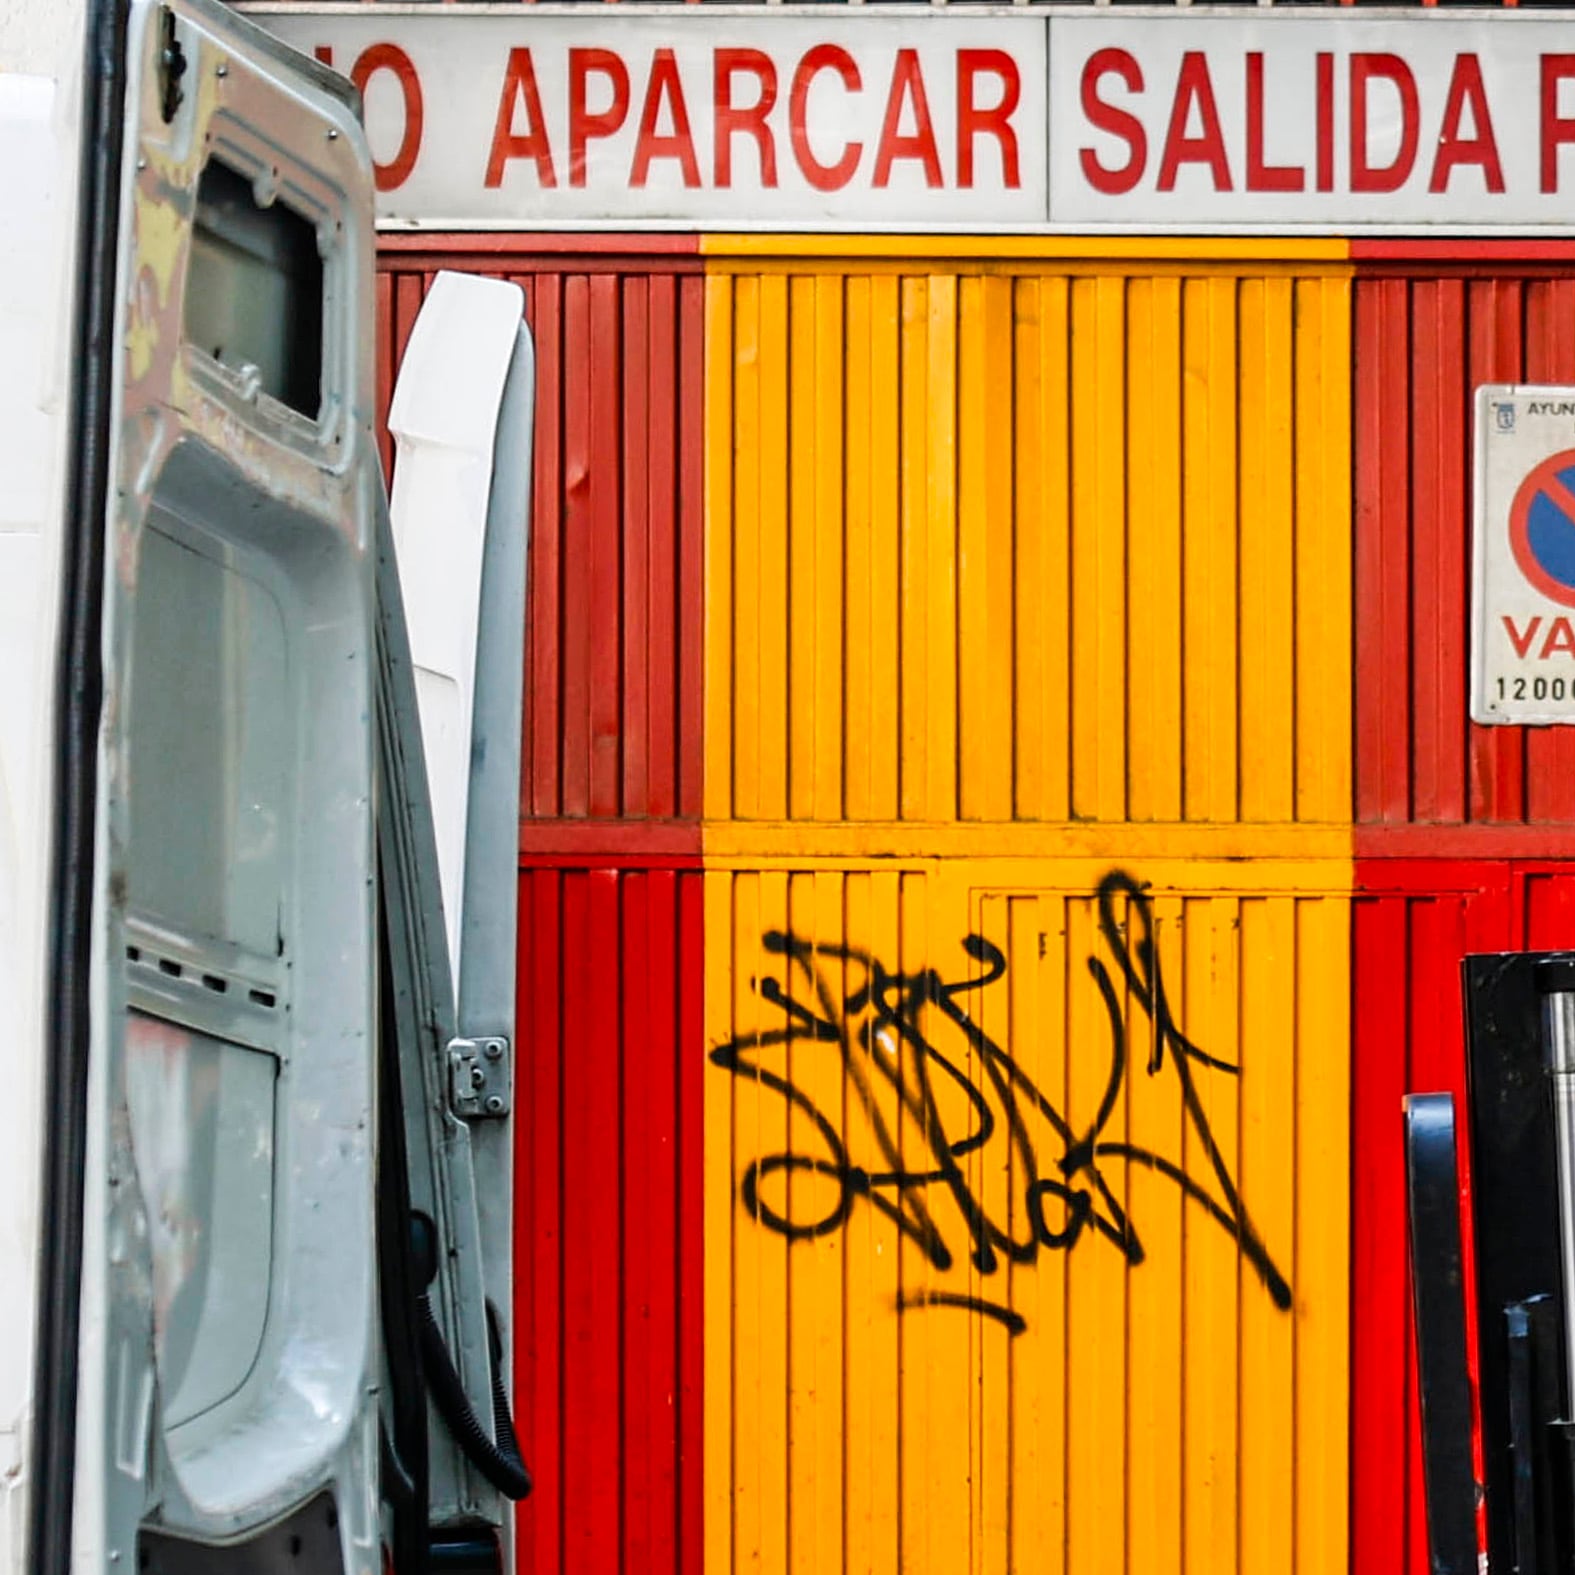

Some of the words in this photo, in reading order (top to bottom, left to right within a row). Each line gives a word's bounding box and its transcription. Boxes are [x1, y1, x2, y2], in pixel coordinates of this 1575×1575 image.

[314, 43, 423, 192] O
[484, 42, 1022, 192] APARCAR
[1079, 48, 1506, 196] SALIDA
